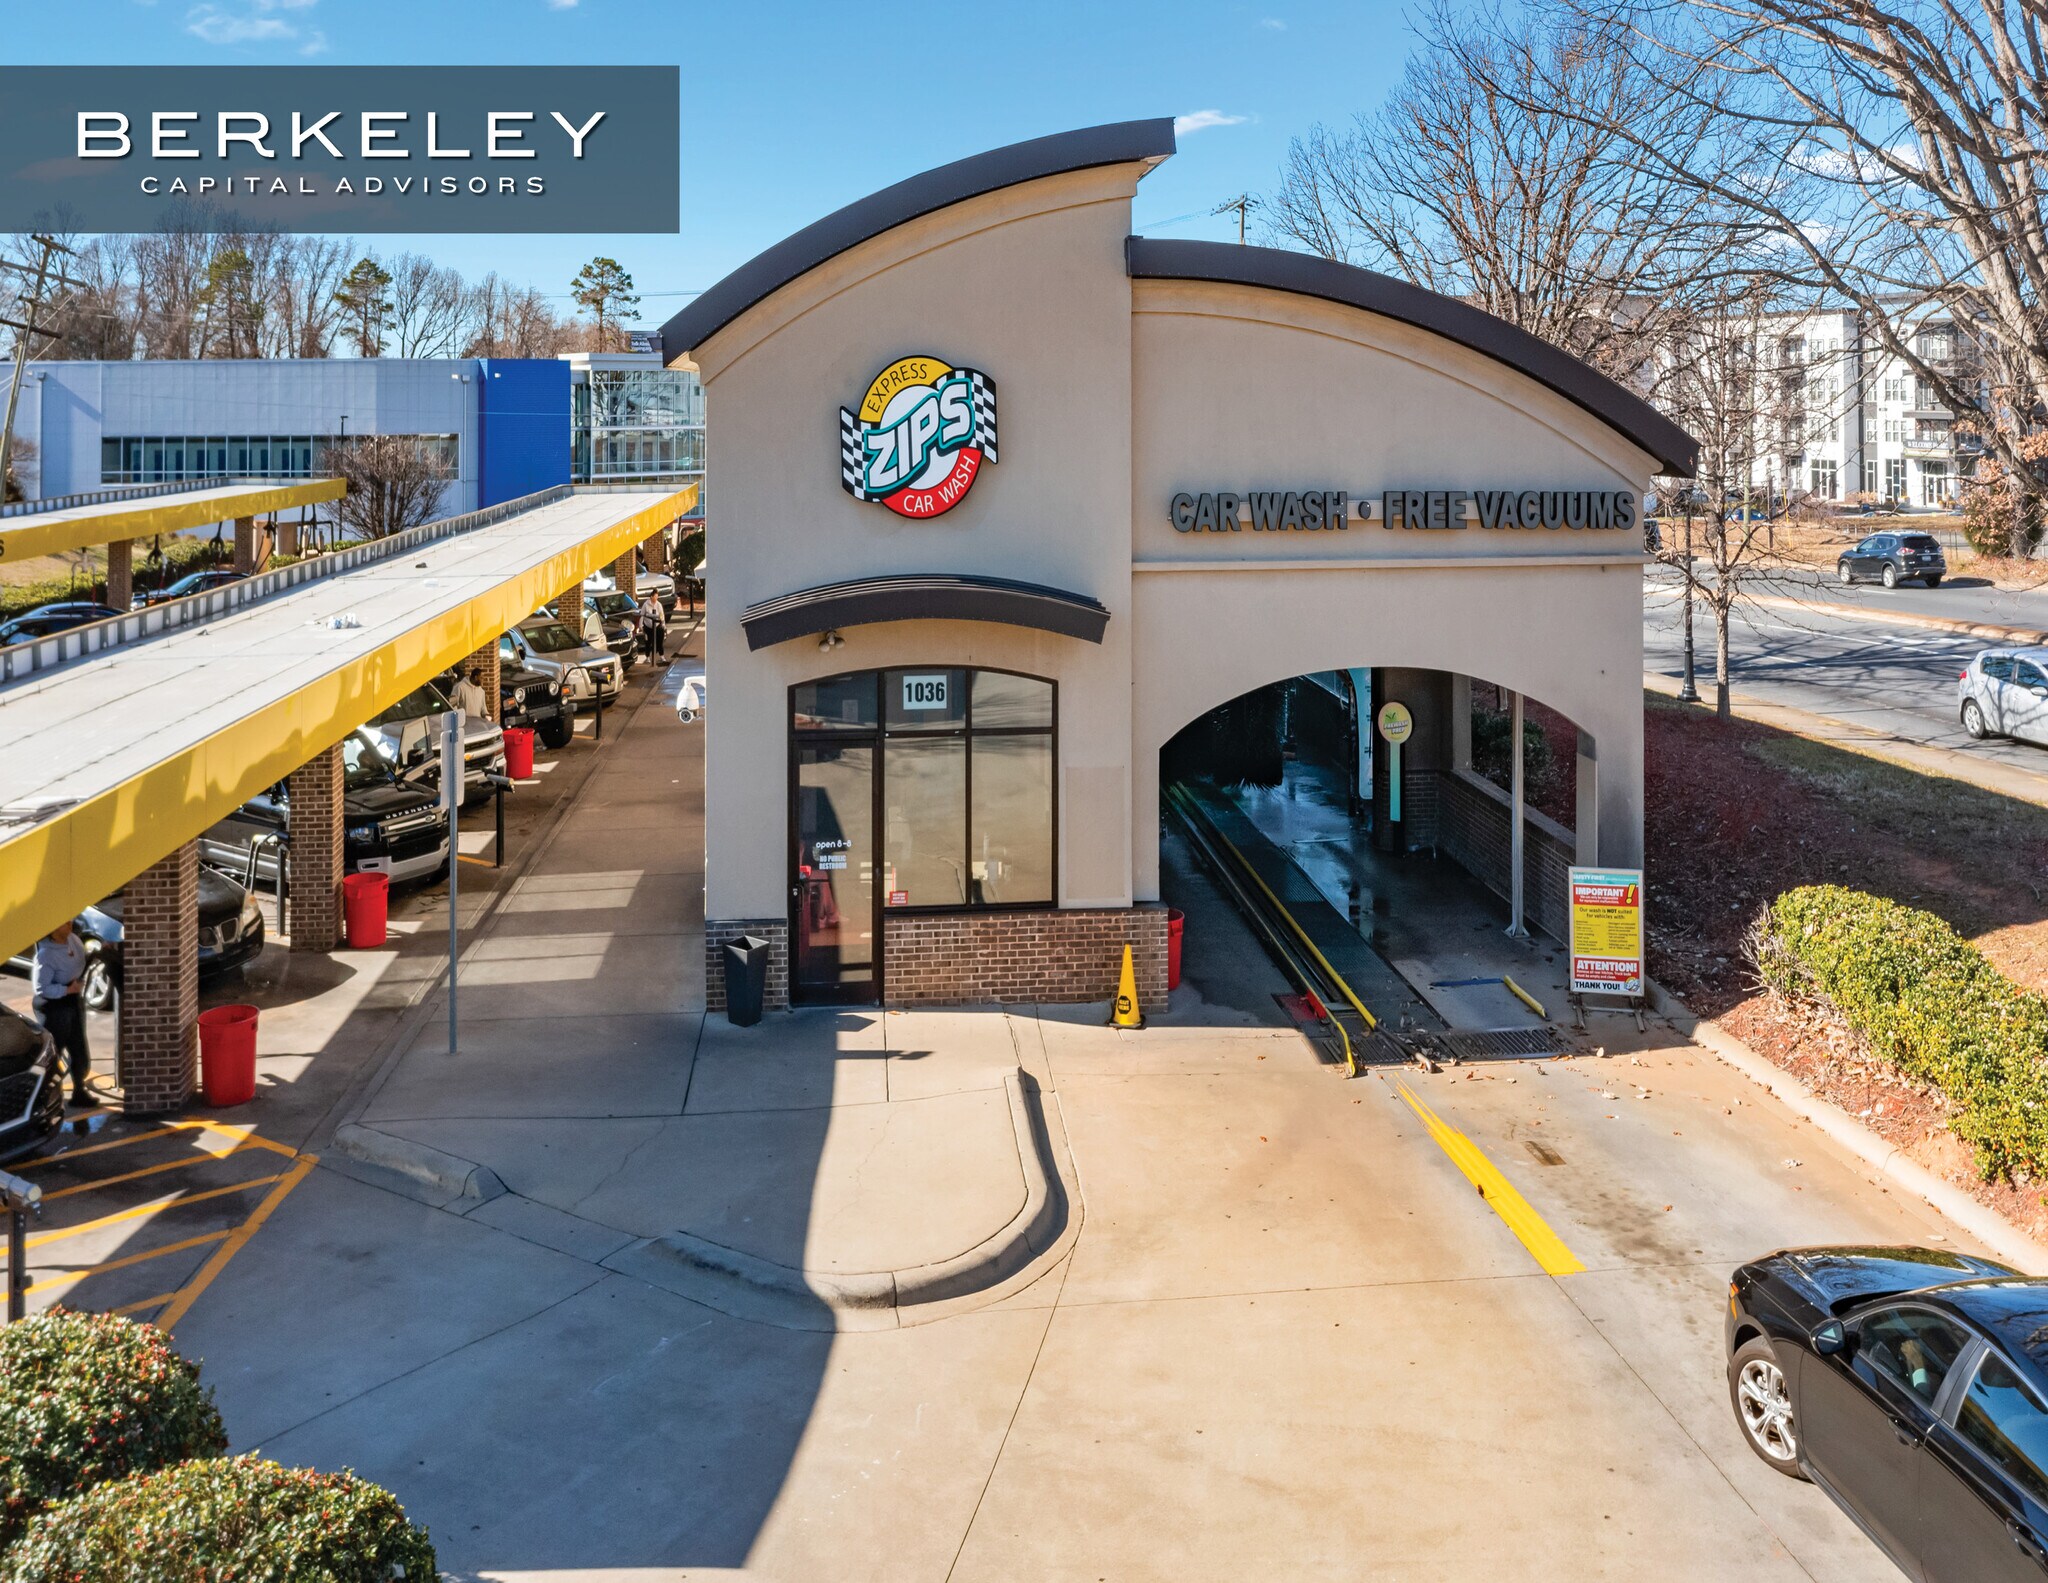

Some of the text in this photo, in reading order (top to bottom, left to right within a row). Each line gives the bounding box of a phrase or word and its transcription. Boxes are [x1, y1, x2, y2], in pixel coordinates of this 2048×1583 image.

[867, 363, 927, 413] EXPRESS
[866, 381, 972, 489] ZIPS
[904, 455, 975, 513] CAR WASH
[1171, 490, 1636, 533] CAR WASH FREE VACUUMS
[905, 682, 945, 703] 1036
[385, 803, 434, 819] DEFENDER
[816, 842, 836, 850] open
[1575, 887, 1624, 897] IMPORTANT
[1577, 960, 1637, 973] ATTENTION!
[1575, 981, 1601, 989] THANK
